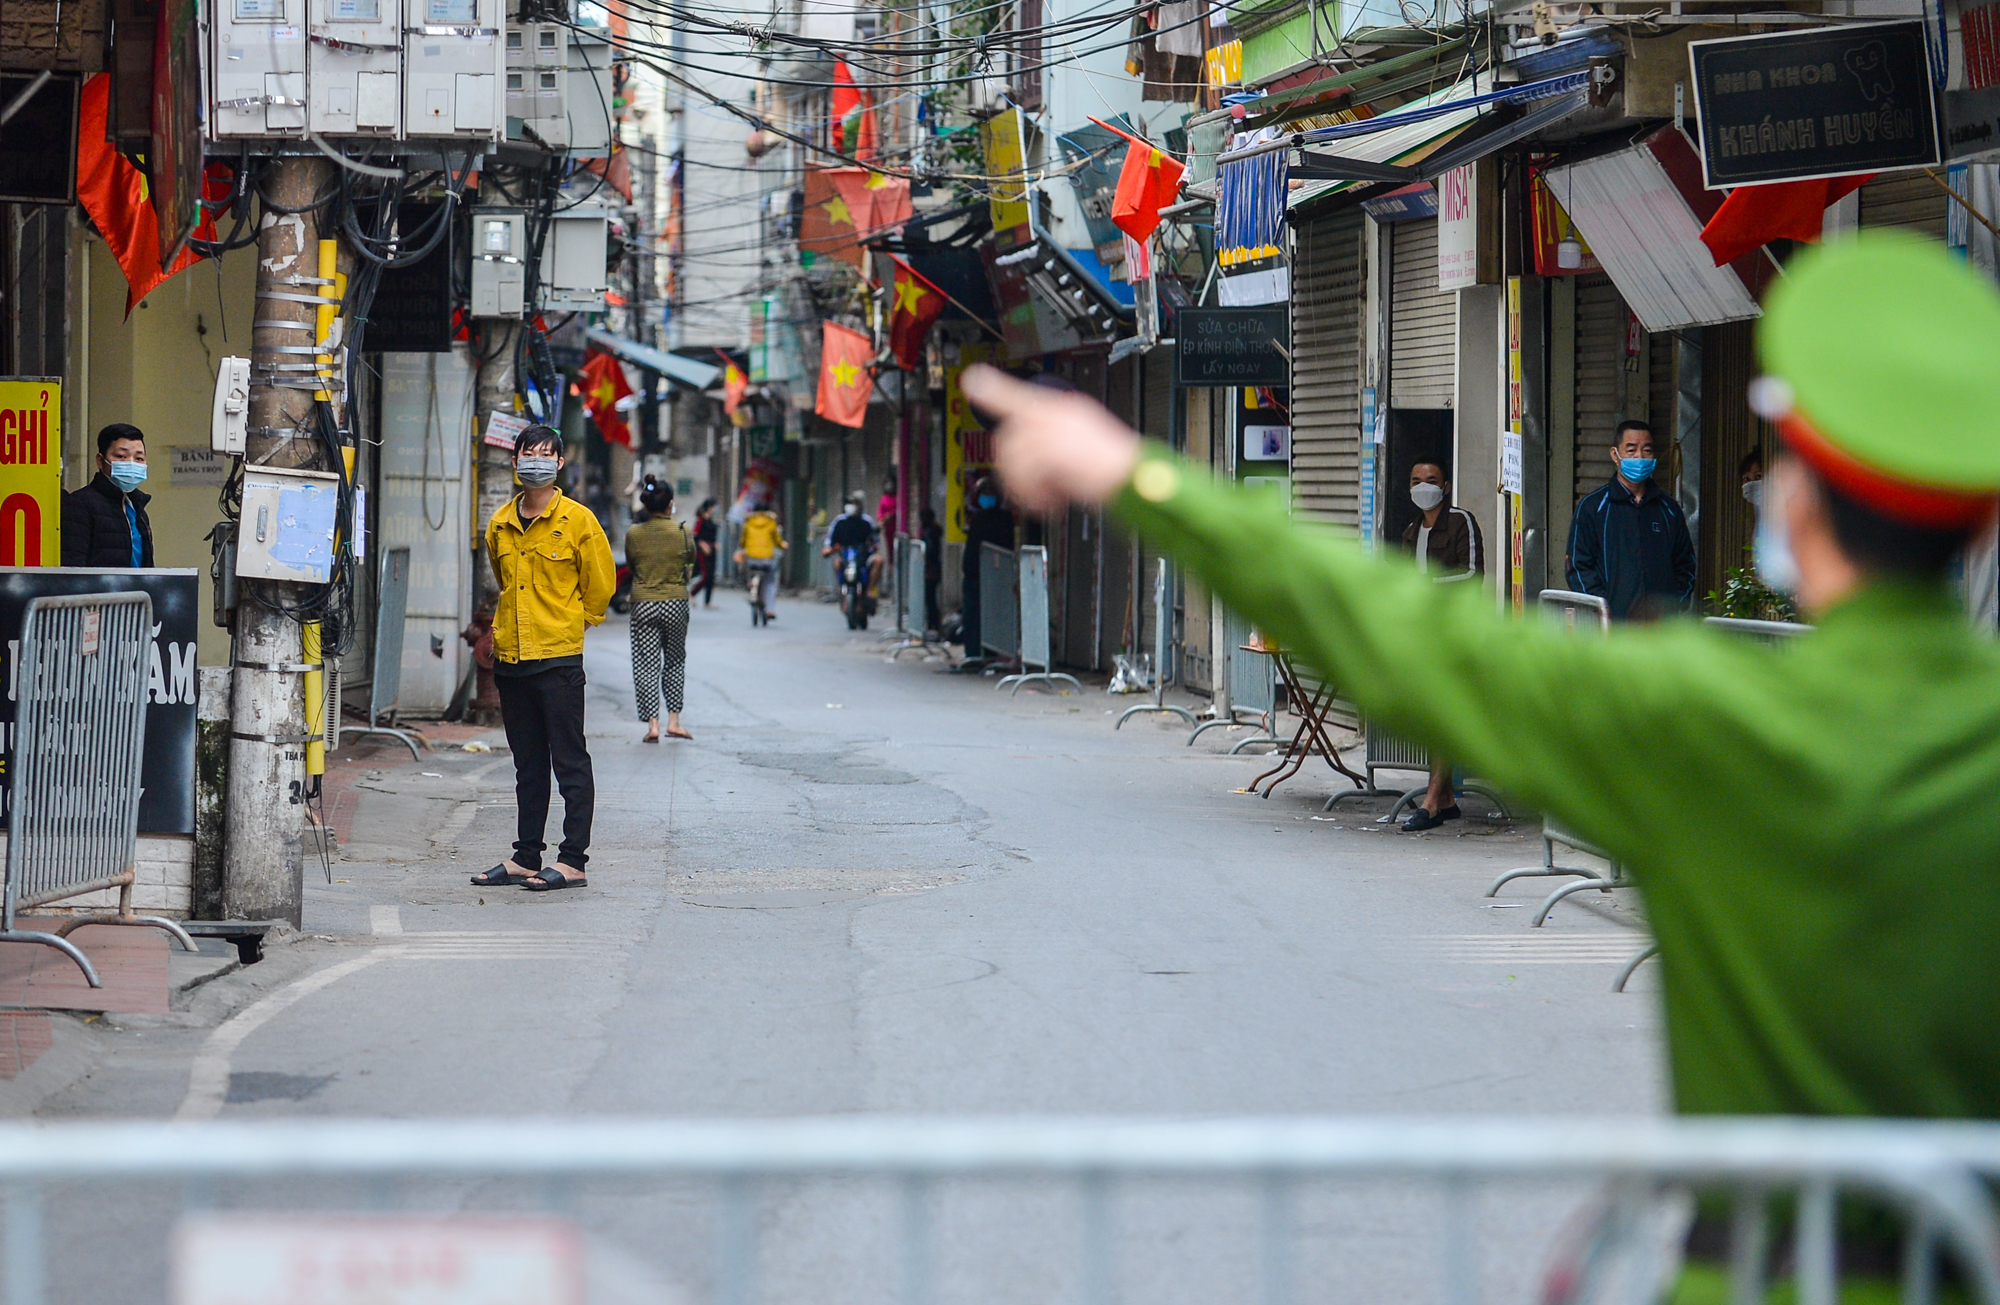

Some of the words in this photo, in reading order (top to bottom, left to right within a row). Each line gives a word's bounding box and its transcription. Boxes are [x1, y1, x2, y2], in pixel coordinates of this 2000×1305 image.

[1713, 70, 1763, 96] NHA
[1770, 62, 1838, 90] KHOA
[1719, 114, 1816, 158] KHÁNH
[1825, 97, 1914, 147] HUYỀN
[1198, 317, 1223, 335] SỬA
[1227, 318, 1266, 335] CHỮA
[1183, 338, 1195, 355] ÉP
[1198, 337, 1221, 355] KÍNH
[1224, 337, 1247, 356] ĐIỆN
[1203, 359, 1224, 375] LẤY
[1228, 363, 1261, 375] NGAY
